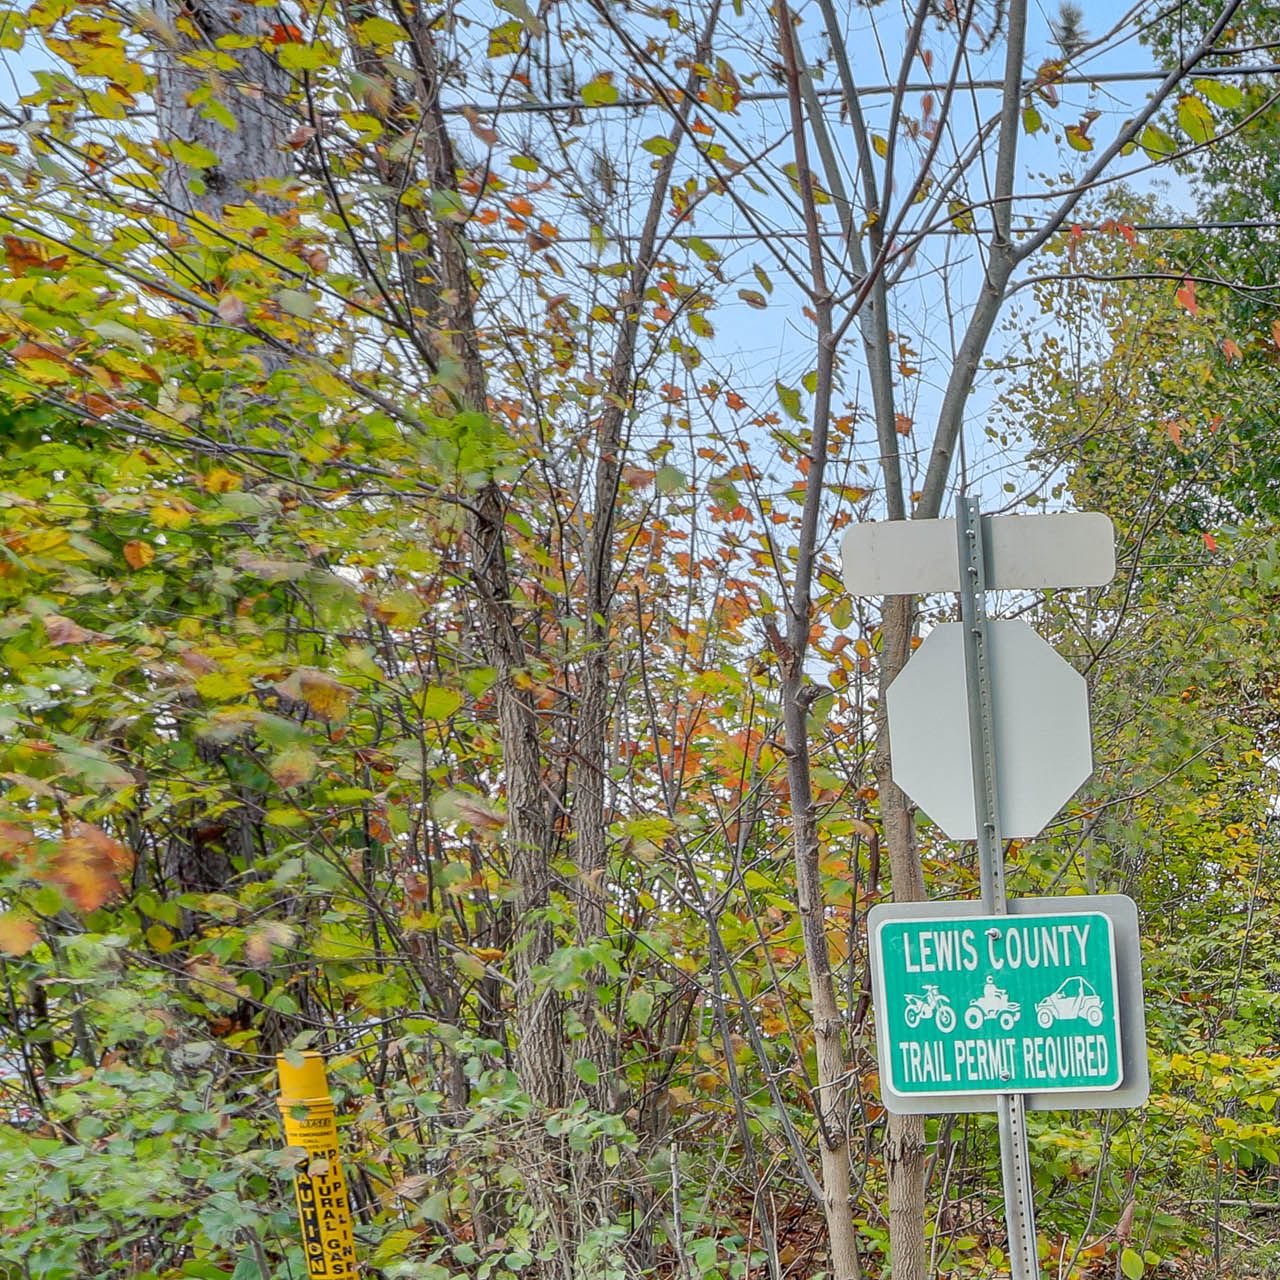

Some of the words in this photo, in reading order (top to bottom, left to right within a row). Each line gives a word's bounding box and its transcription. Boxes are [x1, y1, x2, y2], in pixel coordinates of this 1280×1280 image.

[903, 928, 978, 973] LEWIS
[984, 924, 1090, 970] COUNTY
[899, 1041, 951, 1083] TRAIL
[954, 1037, 1016, 1081] PERMIT
[1023, 1034, 1109, 1079] REQUIRED
[313, 1150, 336, 1231] NTURAL
[327, 1239, 343, 1274] GAS
